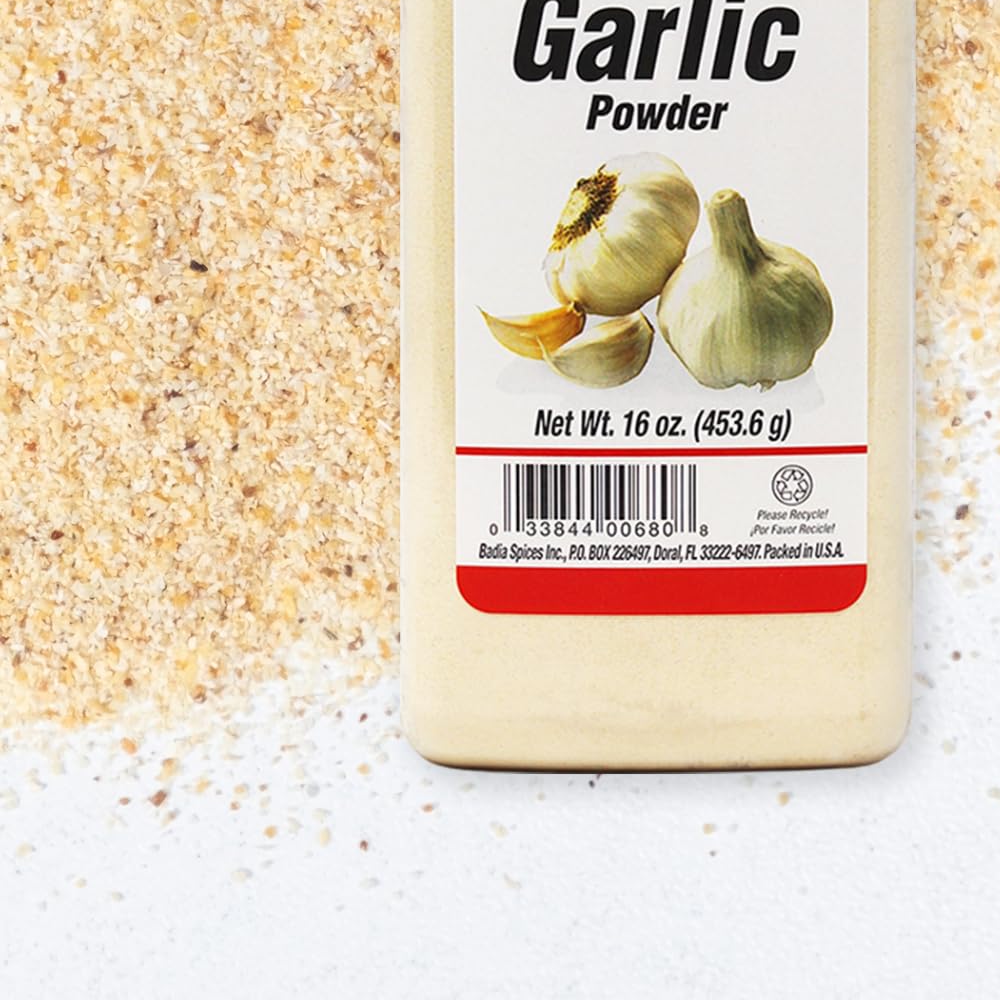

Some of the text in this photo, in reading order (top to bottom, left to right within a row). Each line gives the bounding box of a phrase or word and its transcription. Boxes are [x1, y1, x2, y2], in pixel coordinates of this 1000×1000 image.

[586, 94, 729, 131] Powder
[534, 408, 792, 443] Net Wt. 16 oz. (453.6 g)
[757, 509, 788, 521] Please
[489, 521, 709, 538] 0 33844 00680 8
[770, 524, 797, 536] Favor
[478, 541, 845, 564] Badia Spices Inc., P.O. BOX 226497, Doral, FL 33222-6497. Packed in U.S.A.
